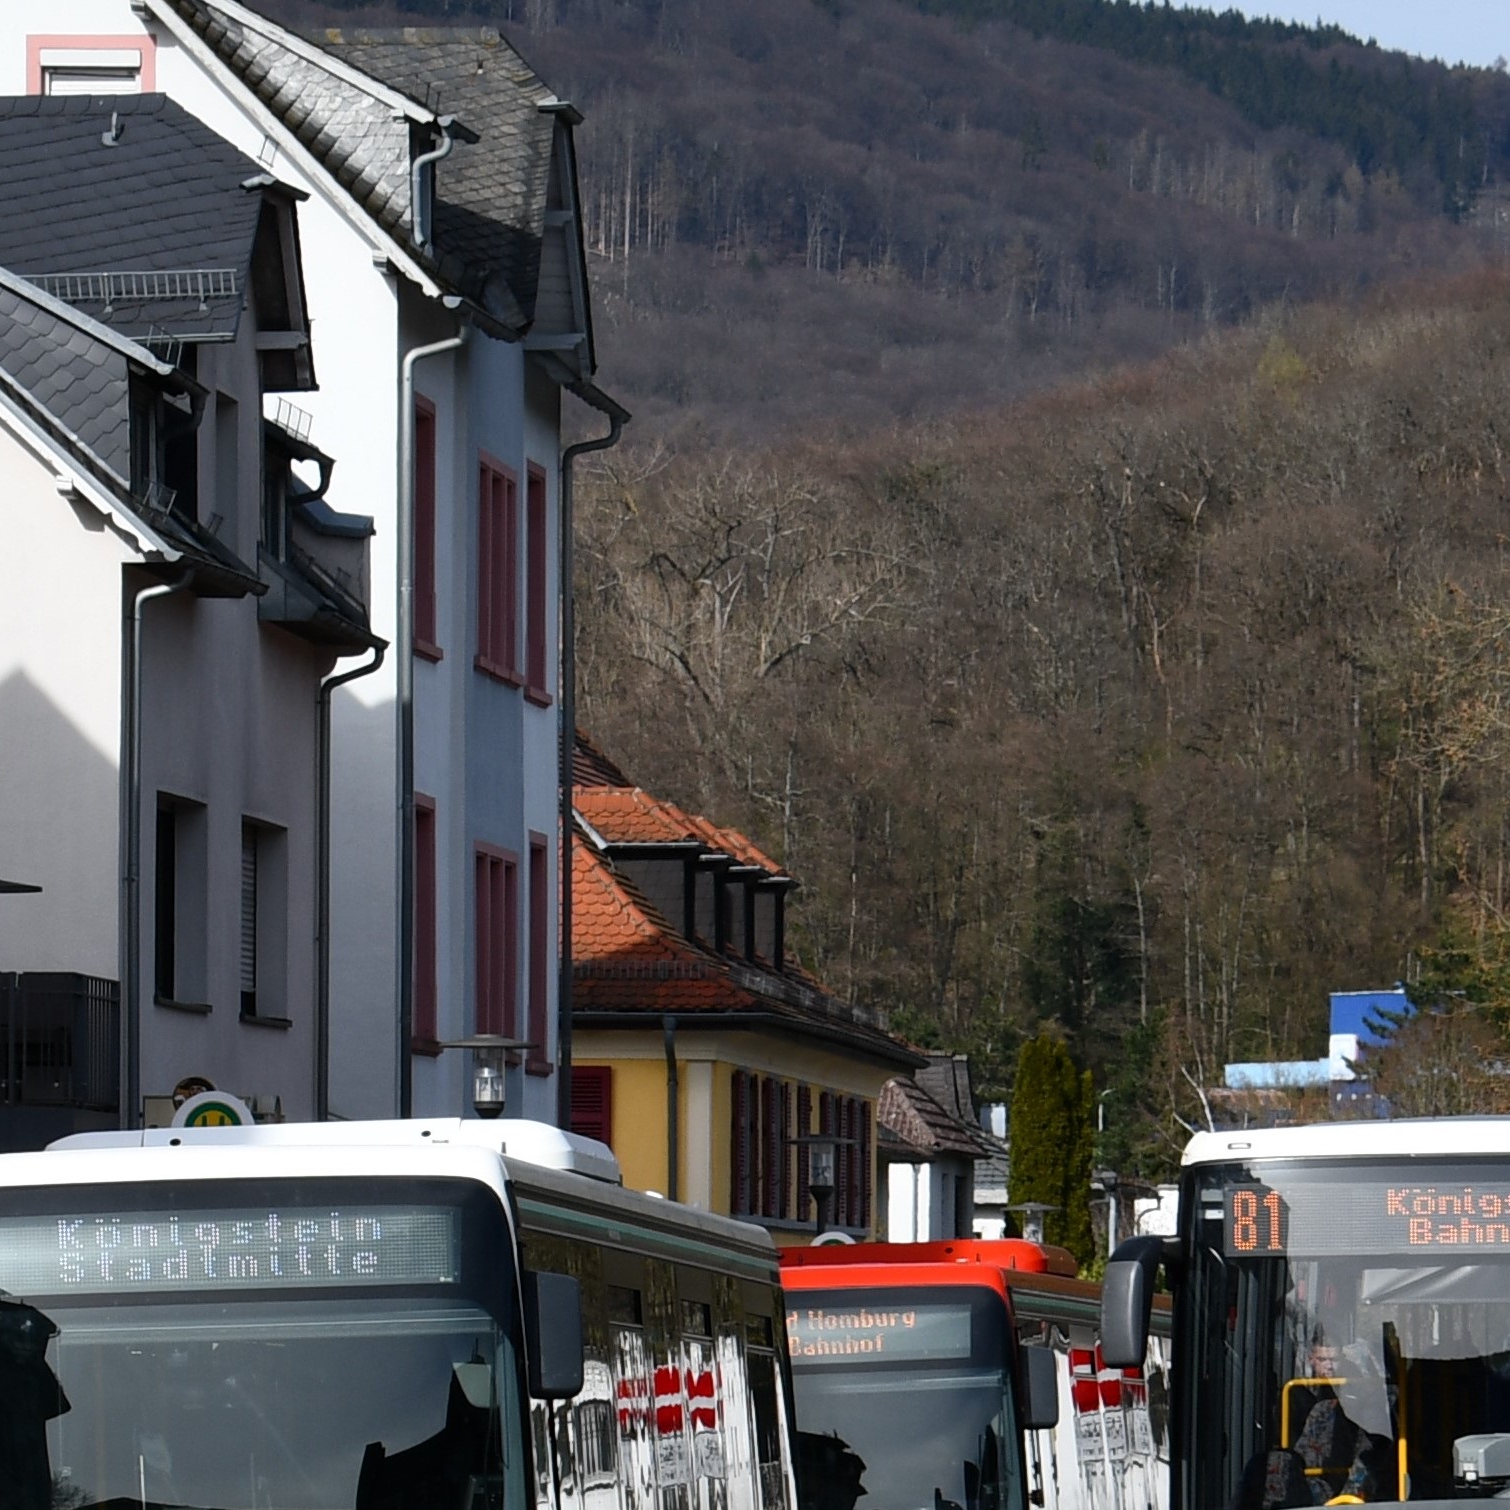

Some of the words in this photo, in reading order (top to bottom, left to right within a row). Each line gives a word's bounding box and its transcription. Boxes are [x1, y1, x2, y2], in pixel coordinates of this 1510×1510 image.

[57, 1212, 382, 1250] Königstein
[1232, 1189, 1283, 1251] 81
[59, 1244, 379, 1283] Stadtmitte
[808, 1308, 917, 1331] Homburg
[788, 1333, 885, 1357] Bahnhof
